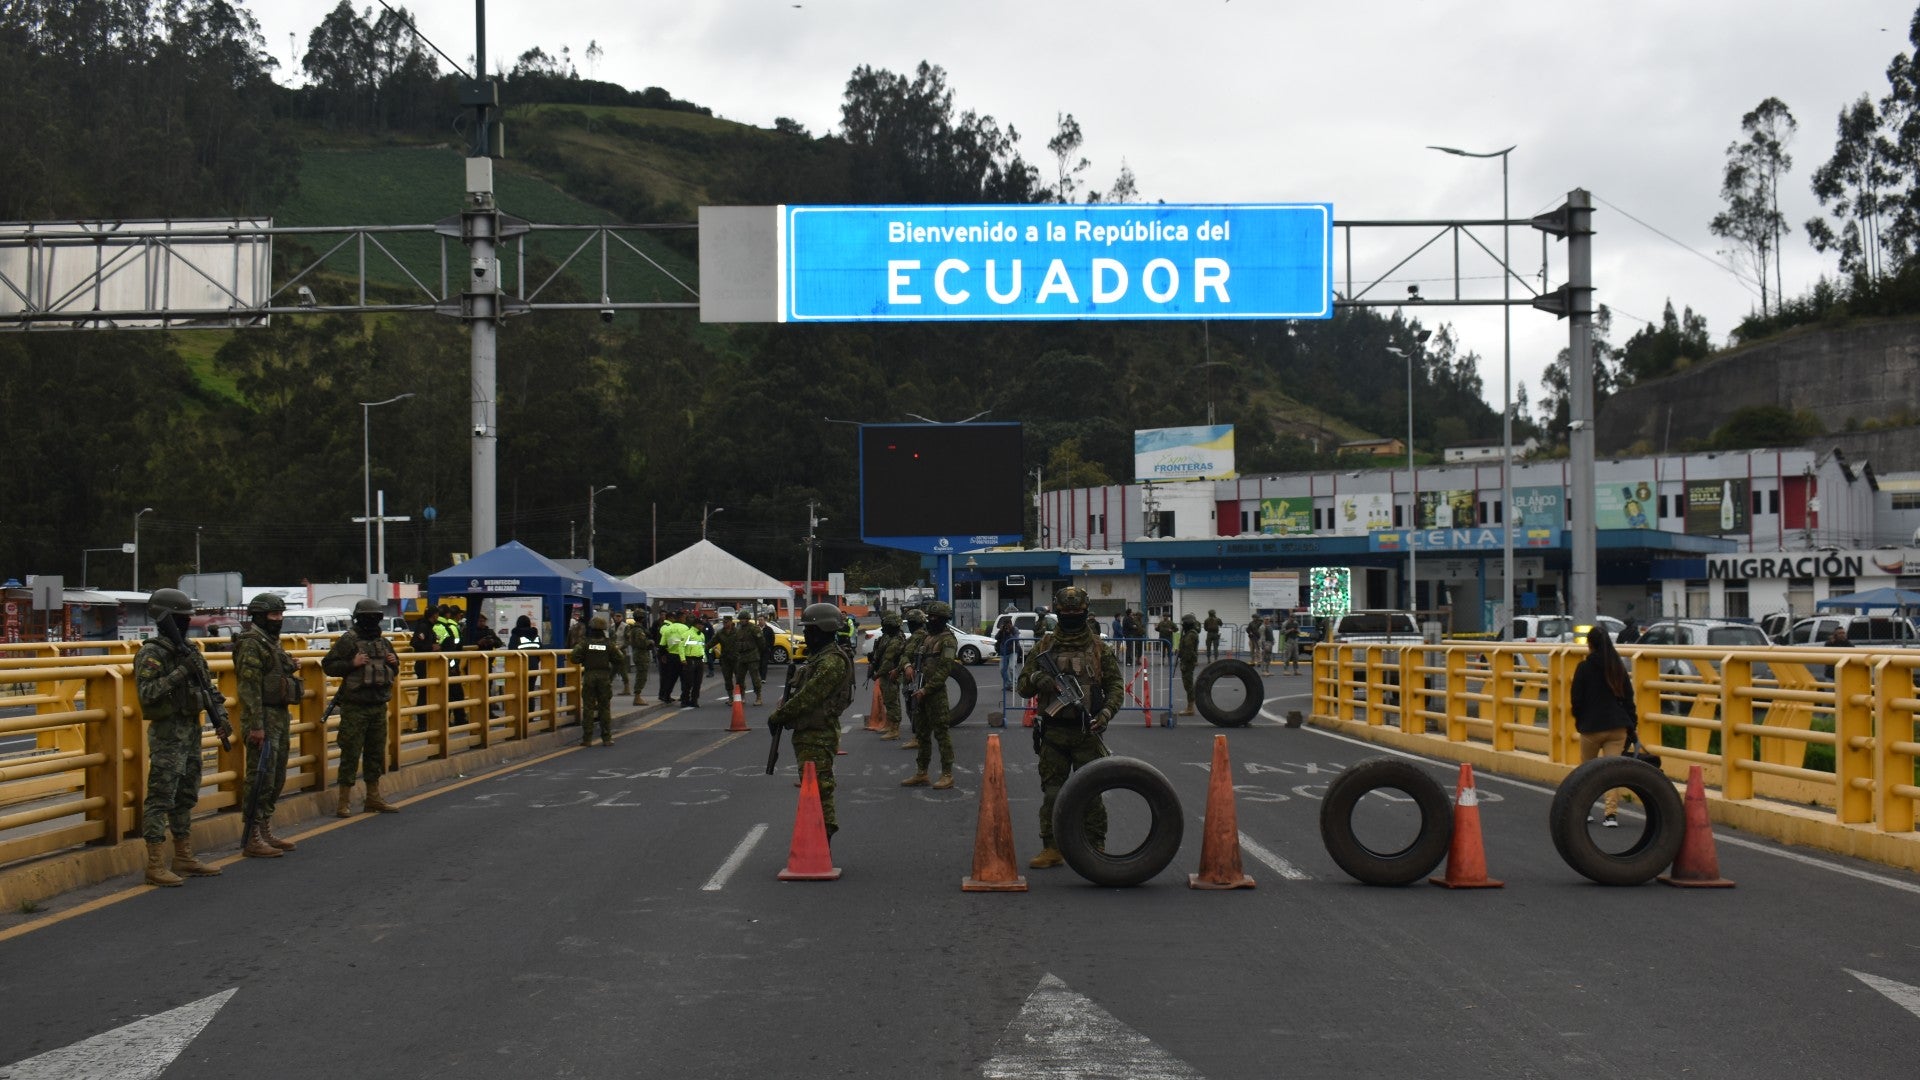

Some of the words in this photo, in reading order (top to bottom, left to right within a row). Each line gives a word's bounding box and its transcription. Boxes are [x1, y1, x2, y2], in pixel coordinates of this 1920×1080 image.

[889, 221, 1017, 243] Bienvenido
[1025, 227, 1038, 243] a
[1047, 221, 1066, 242] la
[1075, 220, 1188, 247] República
[1197, 220, 1229, 242] del
[888, 257, 1231, 305] ECUADOR
[1154, 462, 1214, 472] FRONTERAS
[1516, 495, 1556, 507] BLANCO
[1690, 493, 1720, 501] BULL
[1708, 552, 1862, 579] MIGRACIÓN
[484, 578, 520, 586] DESINFECCIÓN
